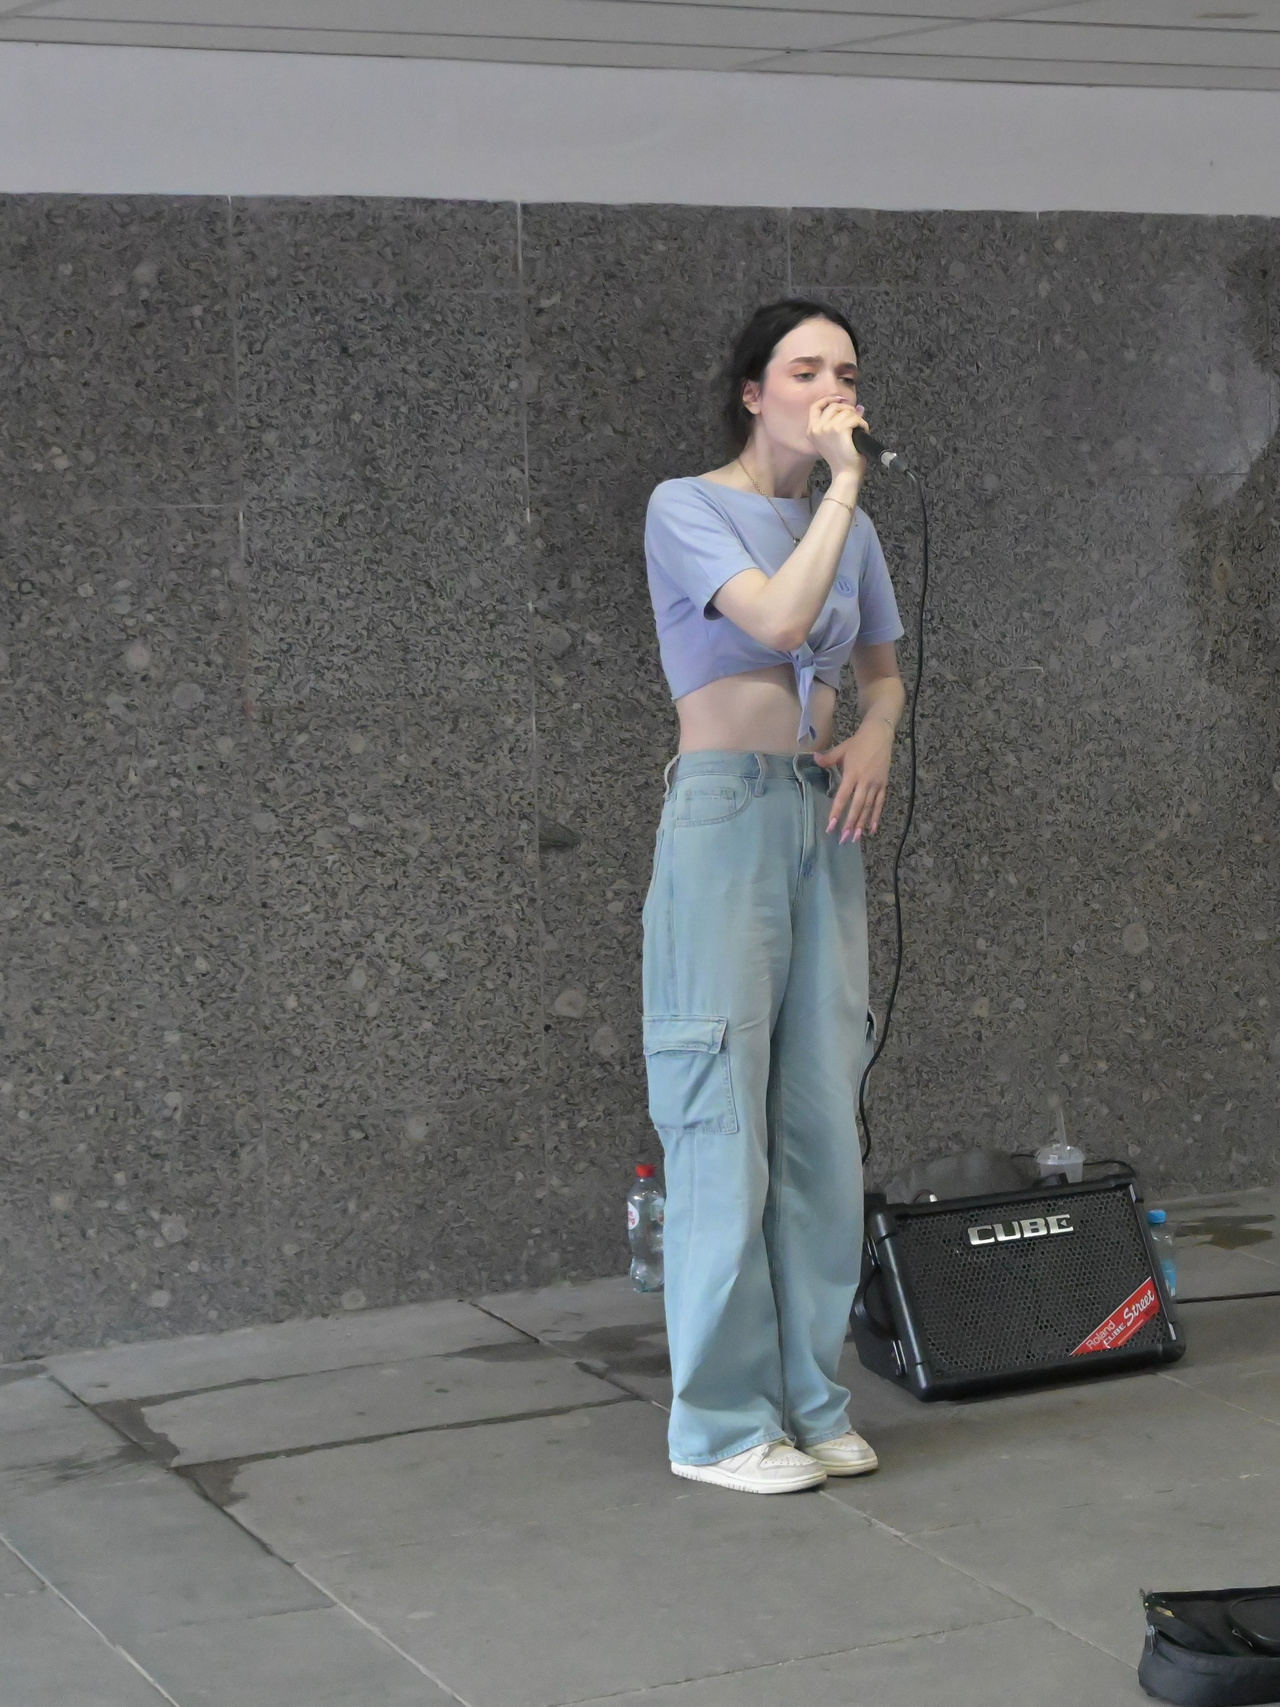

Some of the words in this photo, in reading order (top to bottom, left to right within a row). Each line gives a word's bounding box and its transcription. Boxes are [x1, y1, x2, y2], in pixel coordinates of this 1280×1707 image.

[967, 1214, 1074, 1246] CUBE
[1086, 1320, 1116, 1350] Roland
[1103, 1323, 1127, 1349] CUBE
[1124, 1289, 1155, 1327] Street
